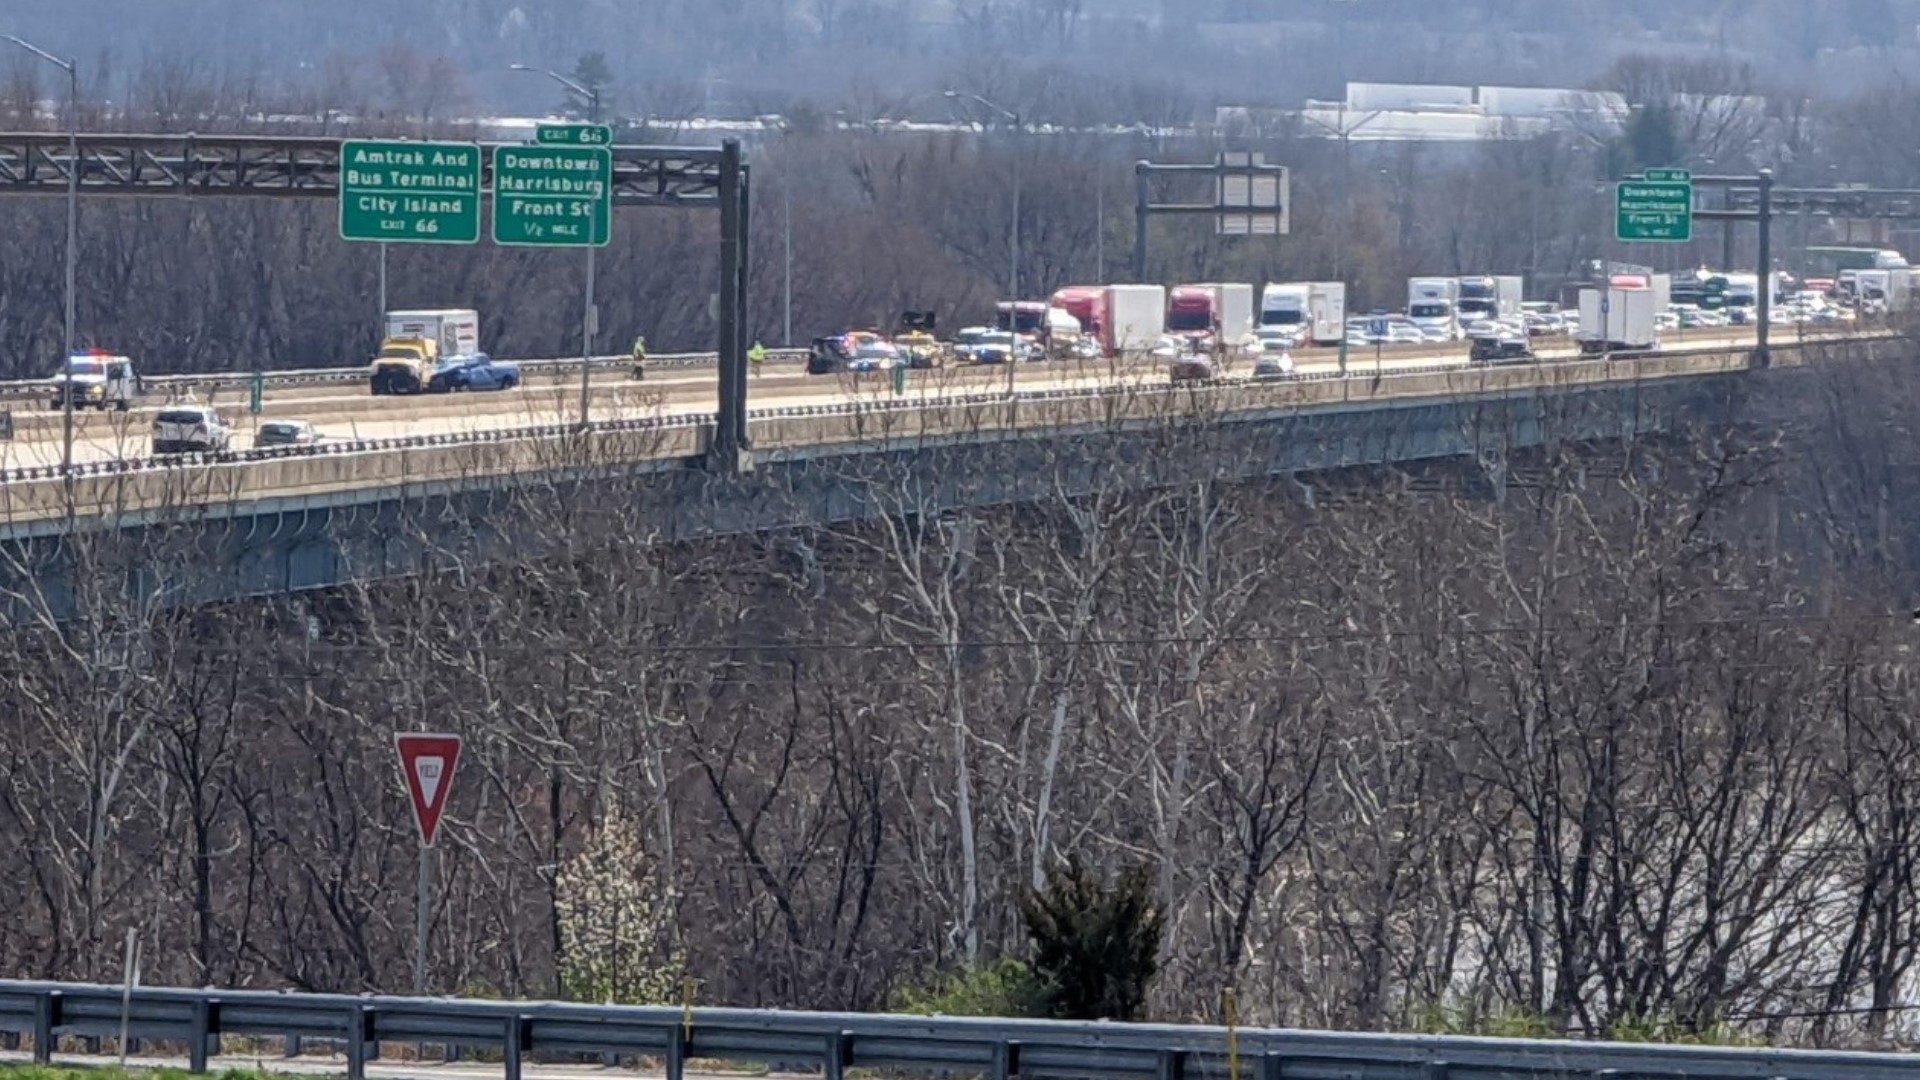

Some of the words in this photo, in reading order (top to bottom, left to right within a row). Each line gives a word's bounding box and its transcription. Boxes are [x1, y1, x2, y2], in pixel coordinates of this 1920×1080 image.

[354, 149, 425, 167] Amtrak
[432, 150, 468, 167] And
[505, 154, 599, 170] Downtown
[347, 170, 382, 186] Bus
[390, 171, 474, 188] Terminal
[500, 175, 604, 198] Harrisburg
[359, 196, 397, 214] City
[404, 197, 463, 214] Island
[512, 201, 563, 215] Front
[570, 201, 592, 216] St
[415, 219, 438, 233] 66
